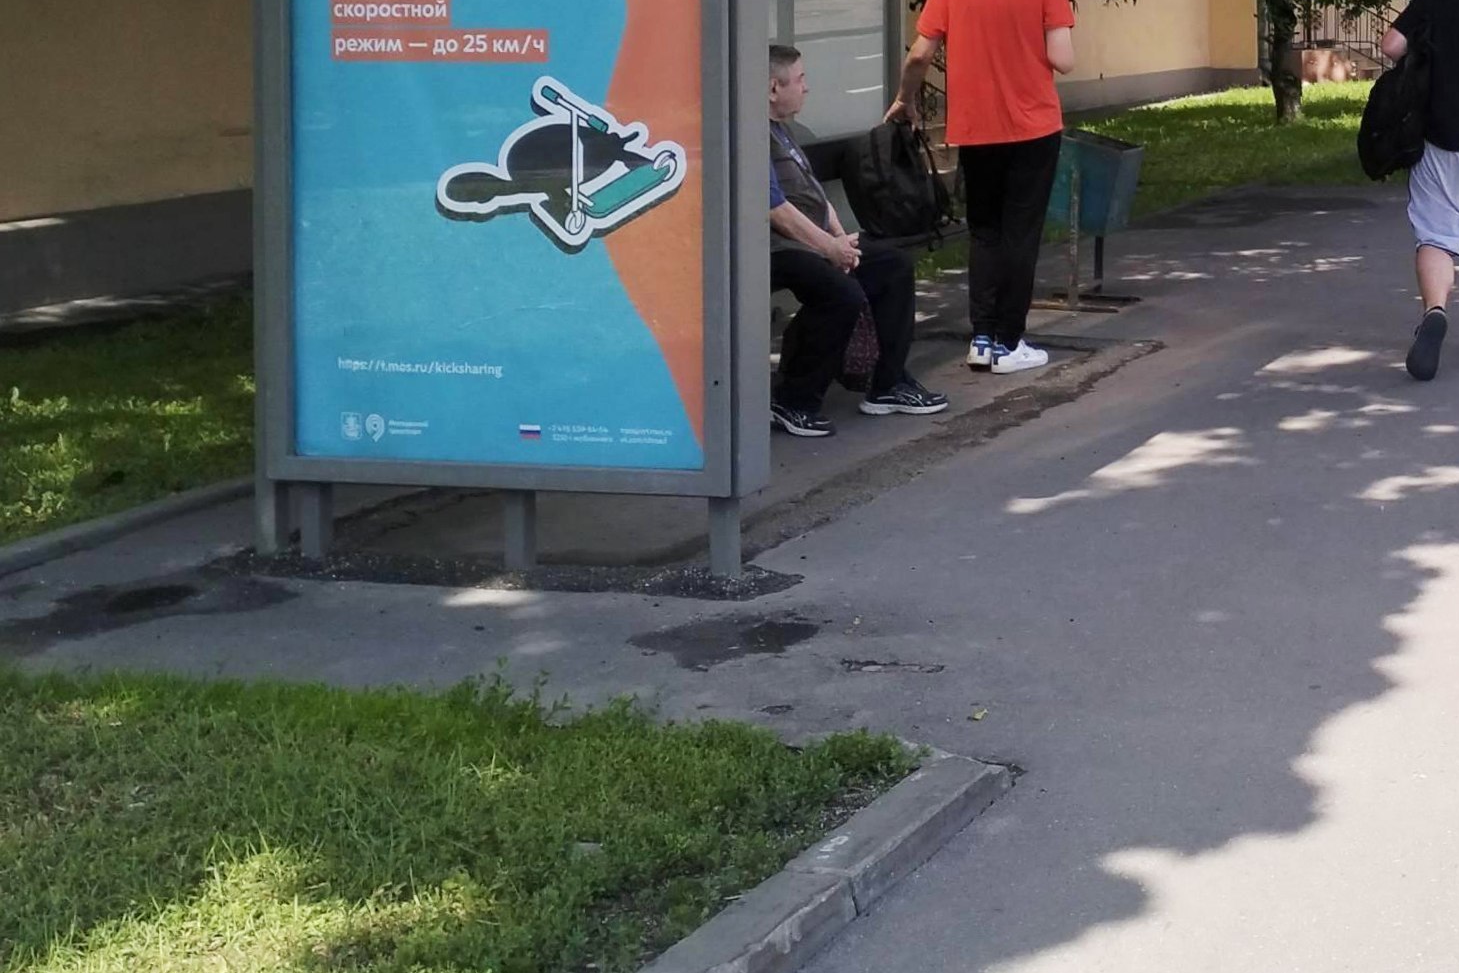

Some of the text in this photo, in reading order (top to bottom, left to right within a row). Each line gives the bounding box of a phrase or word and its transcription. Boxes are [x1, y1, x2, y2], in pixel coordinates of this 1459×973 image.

[333, 0, 448, 21] скоростной
[335, 37, 403, 55] режим
[432, 38, 459, 54] до
[463, 34, 488, 53] 25
[492, 34, 545, 55] км/ч
